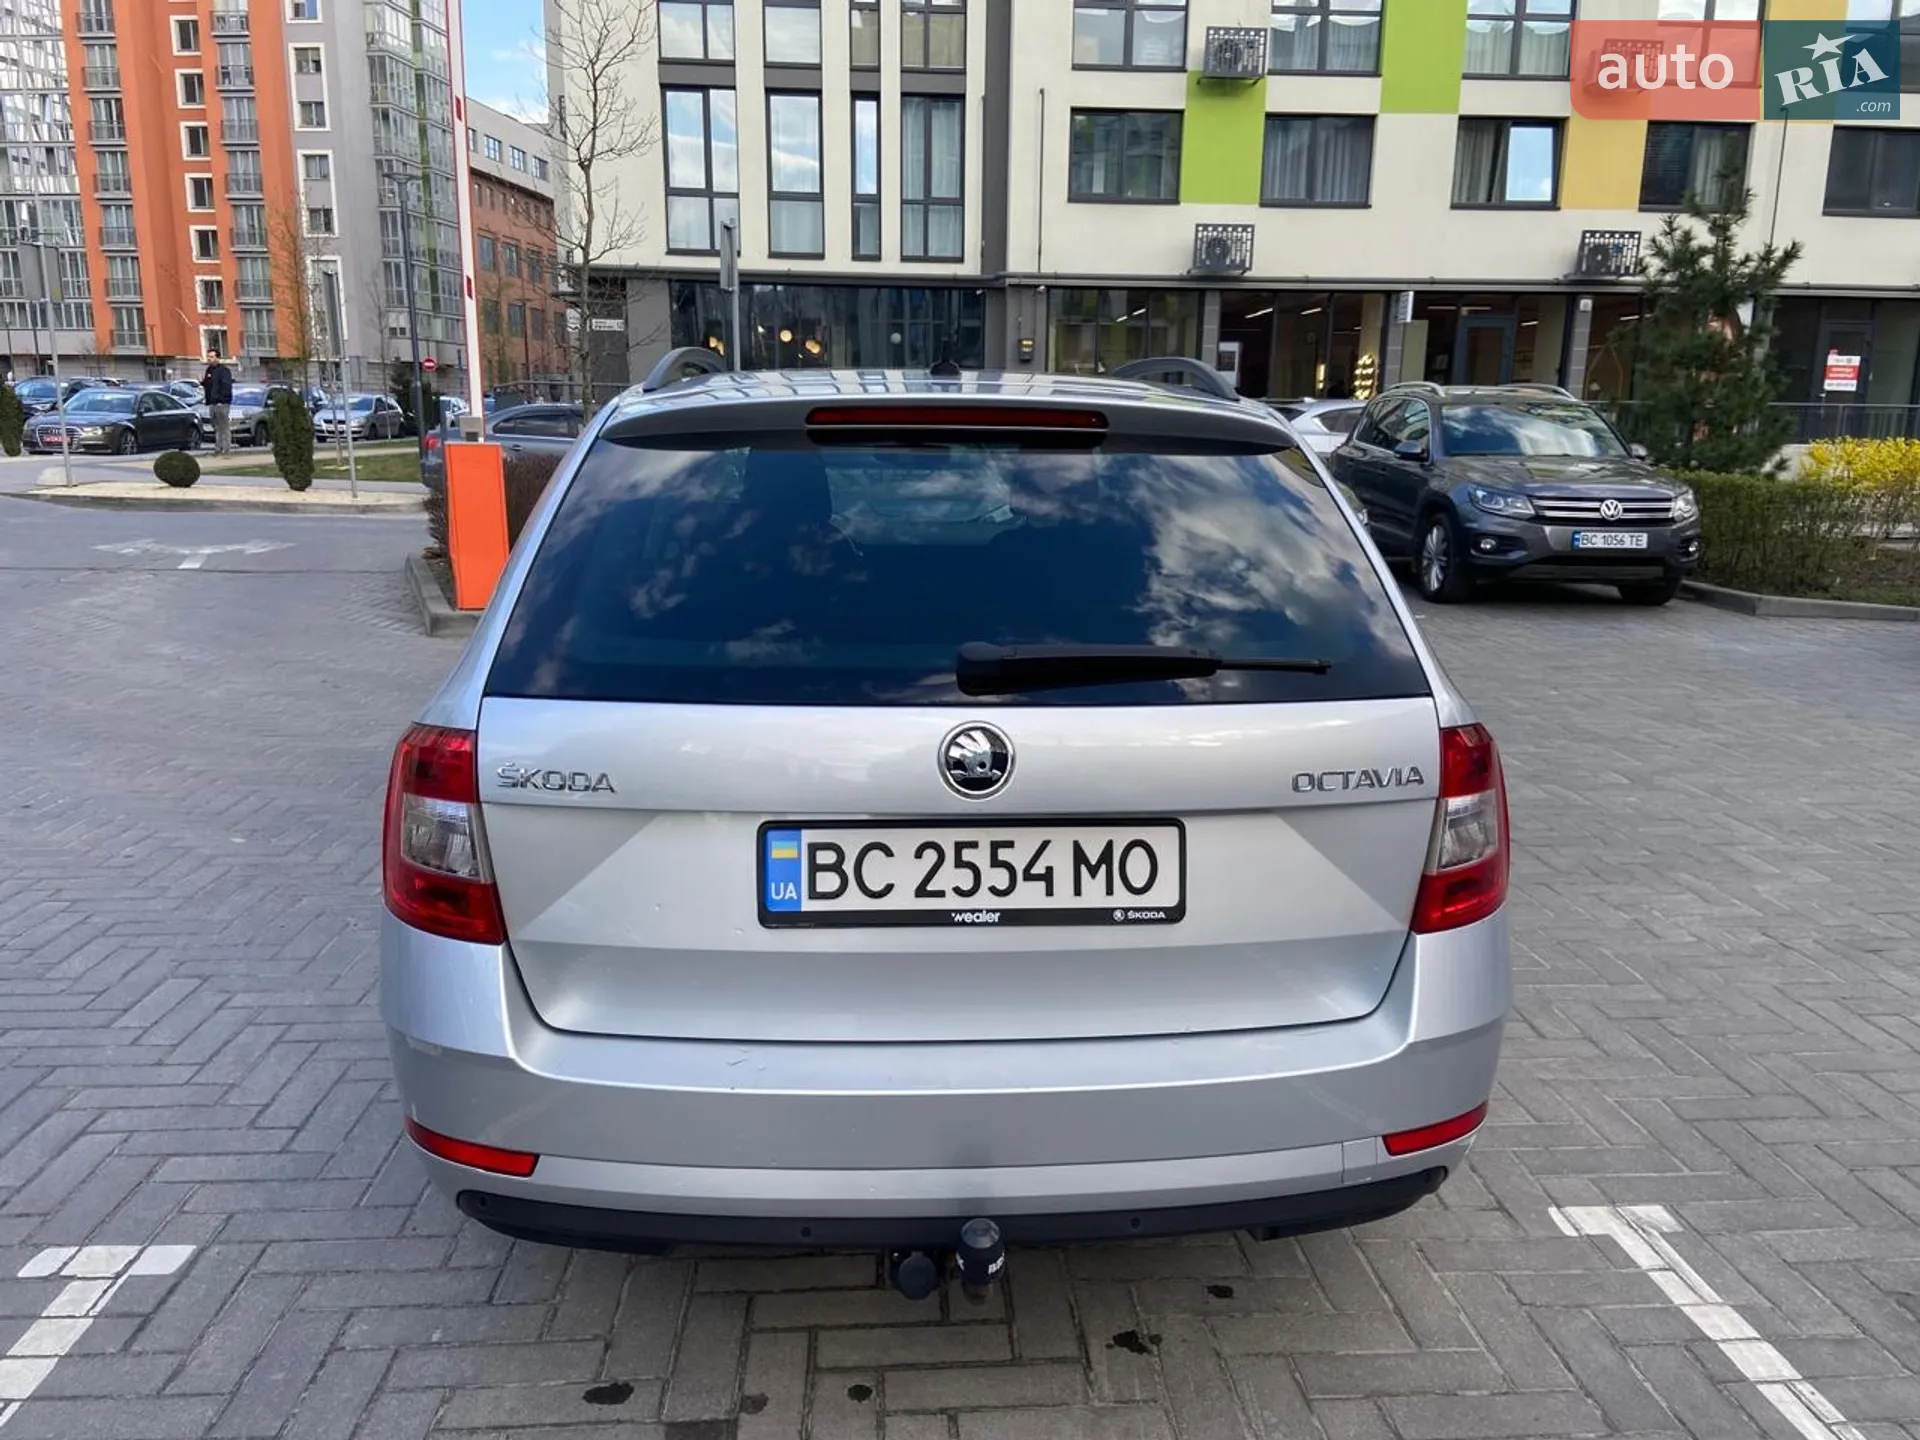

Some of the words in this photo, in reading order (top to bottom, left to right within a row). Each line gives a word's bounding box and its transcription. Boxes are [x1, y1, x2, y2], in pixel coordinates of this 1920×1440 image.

[1581, 534, 1598, 546] BC
[1601, 534, 1625, 546] 1056
[1629, 534, 1643, 546] TE
[1291, 766, 1425, 793] OCTAVIA
[806, 841, 896, 900] BC
[913, 839, 1055, 899] 2554
[1072, 839, 1159, 897] MO
[771, 882, 798, 900] UA
